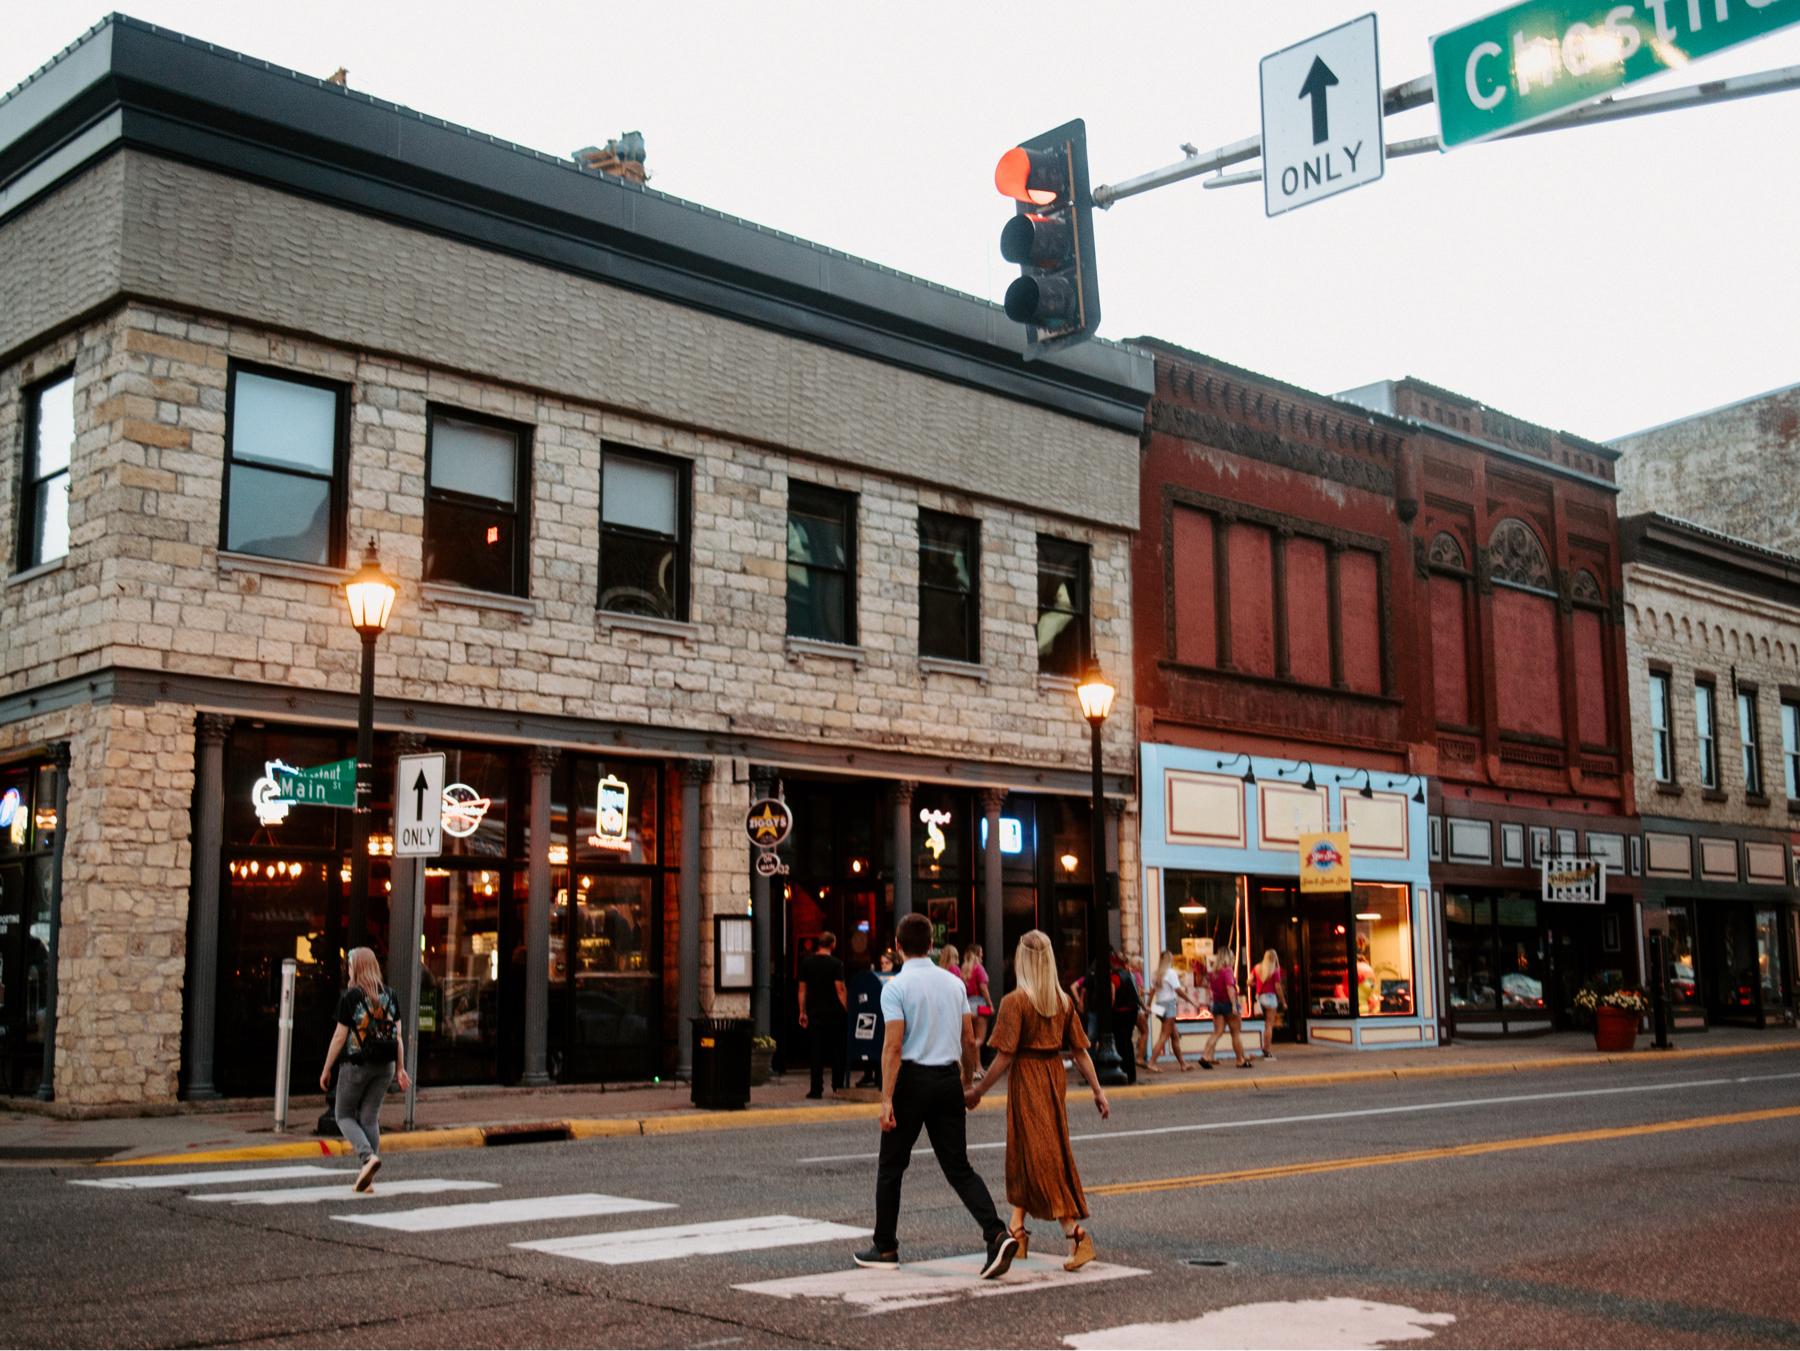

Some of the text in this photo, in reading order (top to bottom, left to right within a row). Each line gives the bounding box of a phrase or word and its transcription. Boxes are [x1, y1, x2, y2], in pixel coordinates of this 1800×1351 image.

[1282, 140, 1363, 196] ONLY
[281, 778, 325, 799] Main
[402, 826, 434, 846] ONLY
